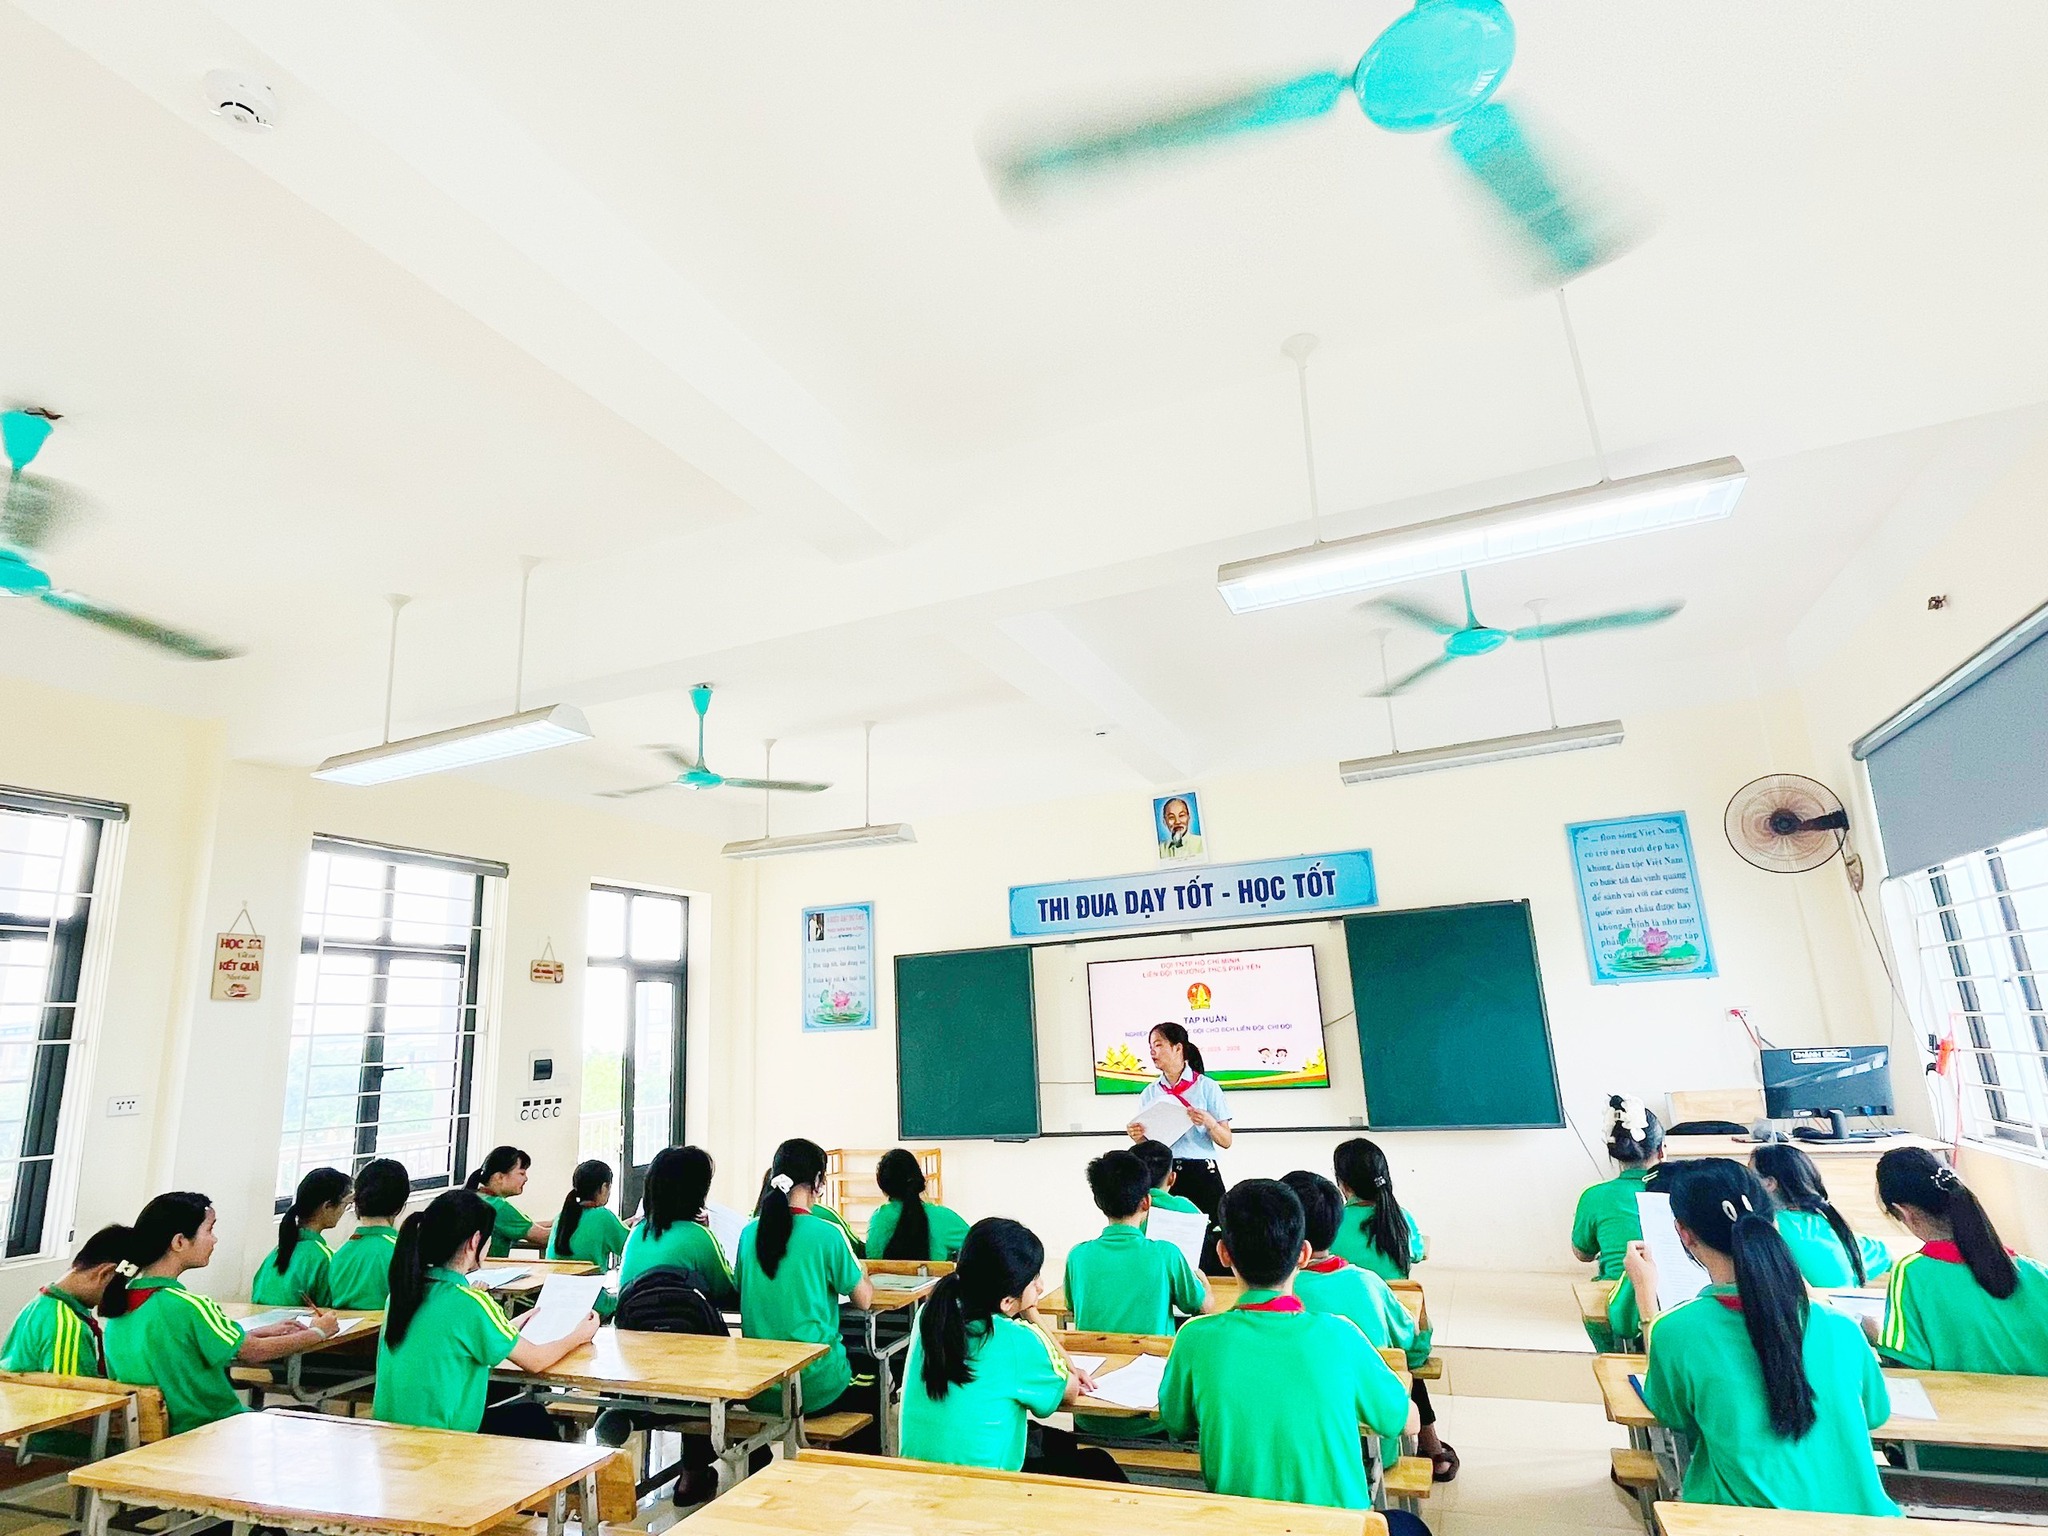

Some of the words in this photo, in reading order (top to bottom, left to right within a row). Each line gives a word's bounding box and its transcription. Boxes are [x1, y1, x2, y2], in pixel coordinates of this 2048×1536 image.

[1037, 896, 1070, 922] THI
[1075, 892, 1118, 919] ĐUA
[1125, 886, 1167, 919] DẠY
[1173, 874, 1214, 909] TỐT
[1237, 874, 1287, 908] HỌC
[1292, 860, 1337, 898] TỐT
[220, 938, 244, 950] HỌC
[219, 959, 239, 971] KẾT
[240, 960, 260, 972] QUẢ
